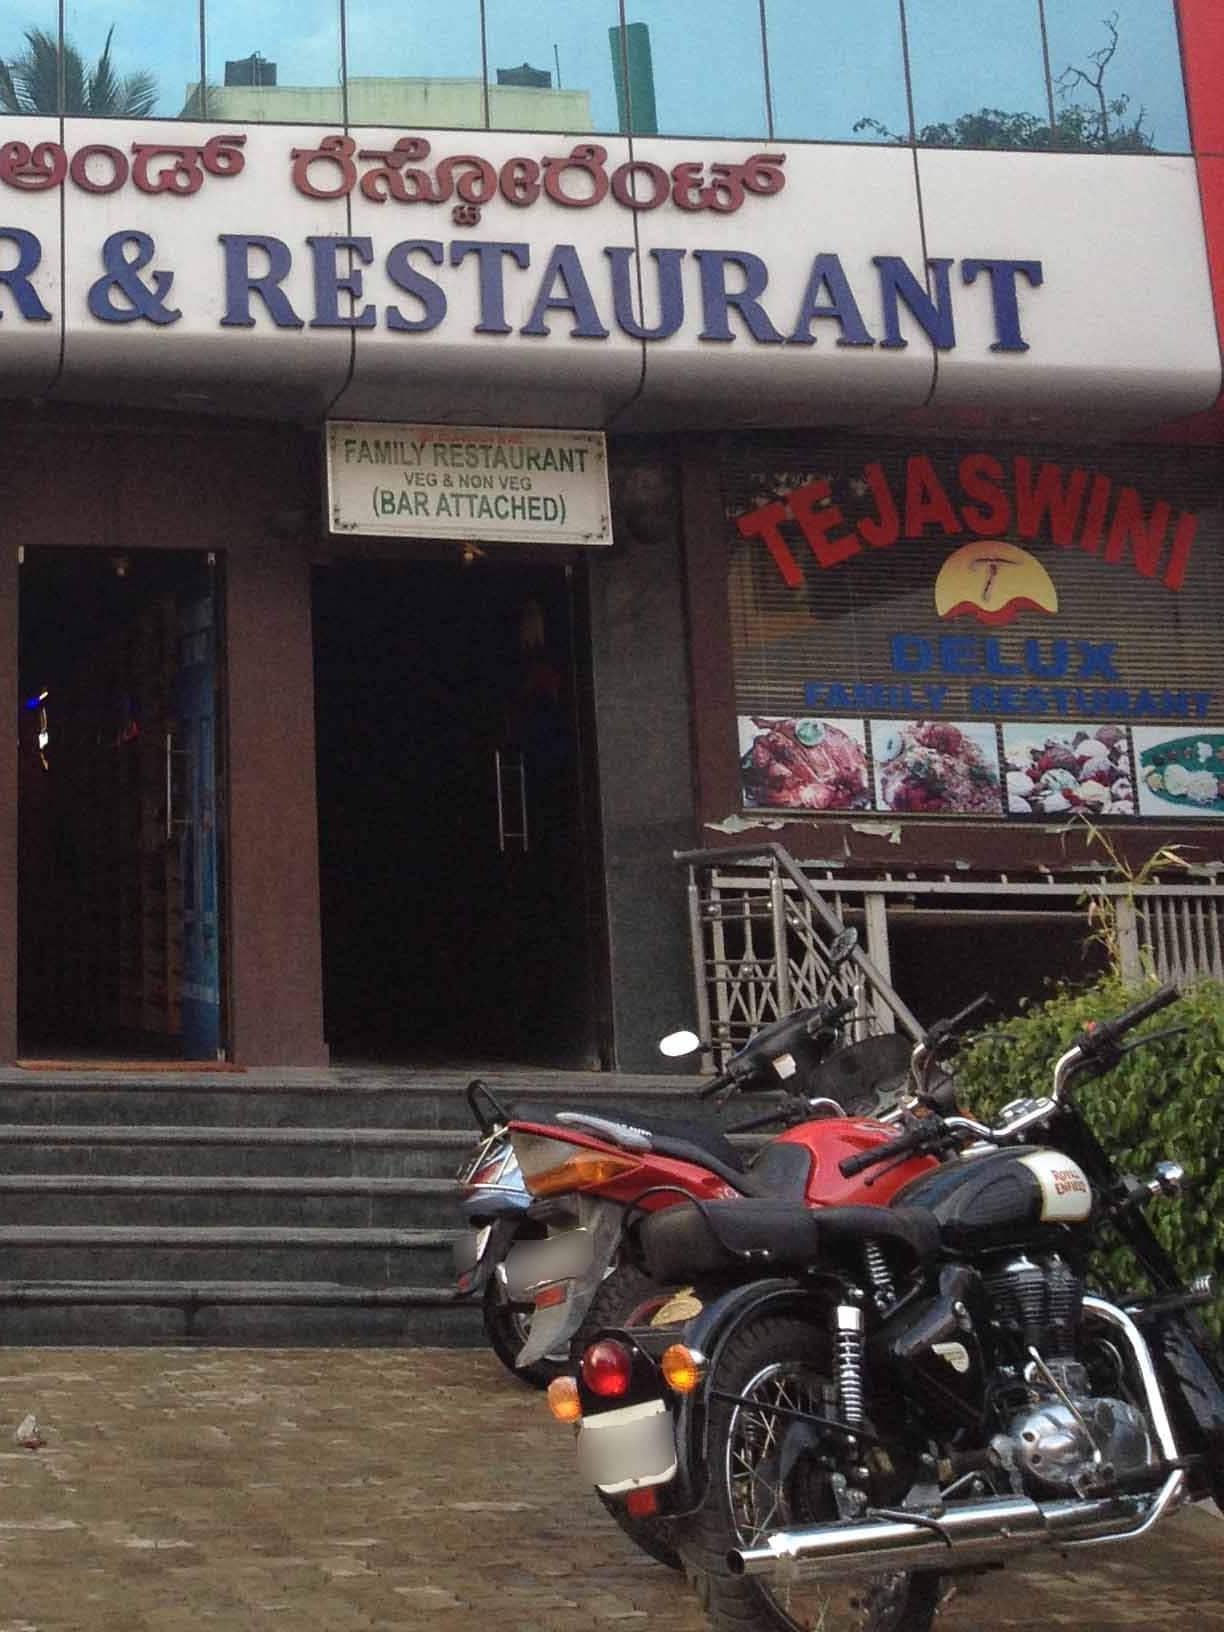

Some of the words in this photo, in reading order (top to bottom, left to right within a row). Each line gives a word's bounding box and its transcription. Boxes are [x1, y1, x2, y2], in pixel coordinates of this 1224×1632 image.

[86, 228, 183, 325] &
[218, 233, 1043, 352] RESTAURANT
[344, 439, 426, 466] FAMILY
[432, 442, 589, 473] RESTAURANT
[403, 471, 438, 487] VEG
[443, 472, 454, 487] &
[459, 474, 494, 489] NON
[499, 475, 532, 491] VEG
[373, 487, 430, 518] (BAR
[435, 492, 566, 525] ATTACHED)
[737, 454, 1199, 593] TEJASWINI
[890, 633, 1121, 681] DELUX
[804, 680, 948, 712] FAMILY
